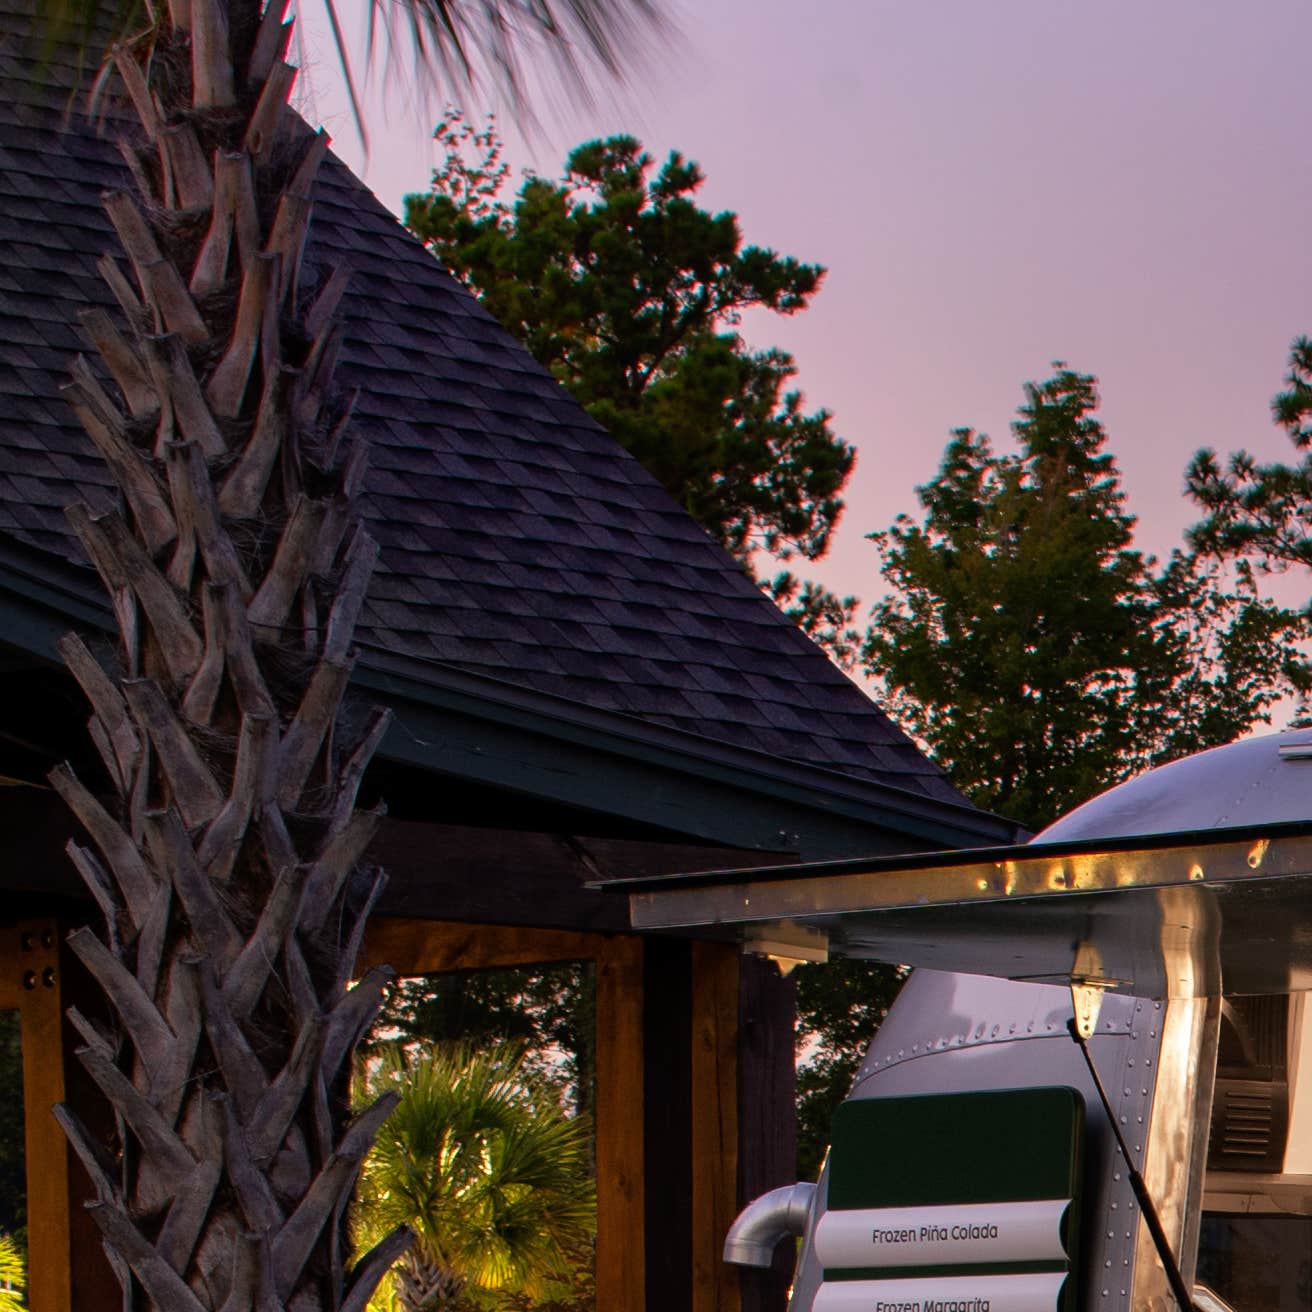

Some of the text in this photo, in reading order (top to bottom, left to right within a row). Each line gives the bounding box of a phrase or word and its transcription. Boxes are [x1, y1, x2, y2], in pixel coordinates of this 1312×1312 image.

[872, 1223, 998, 1244] Frozen Piña Colada
